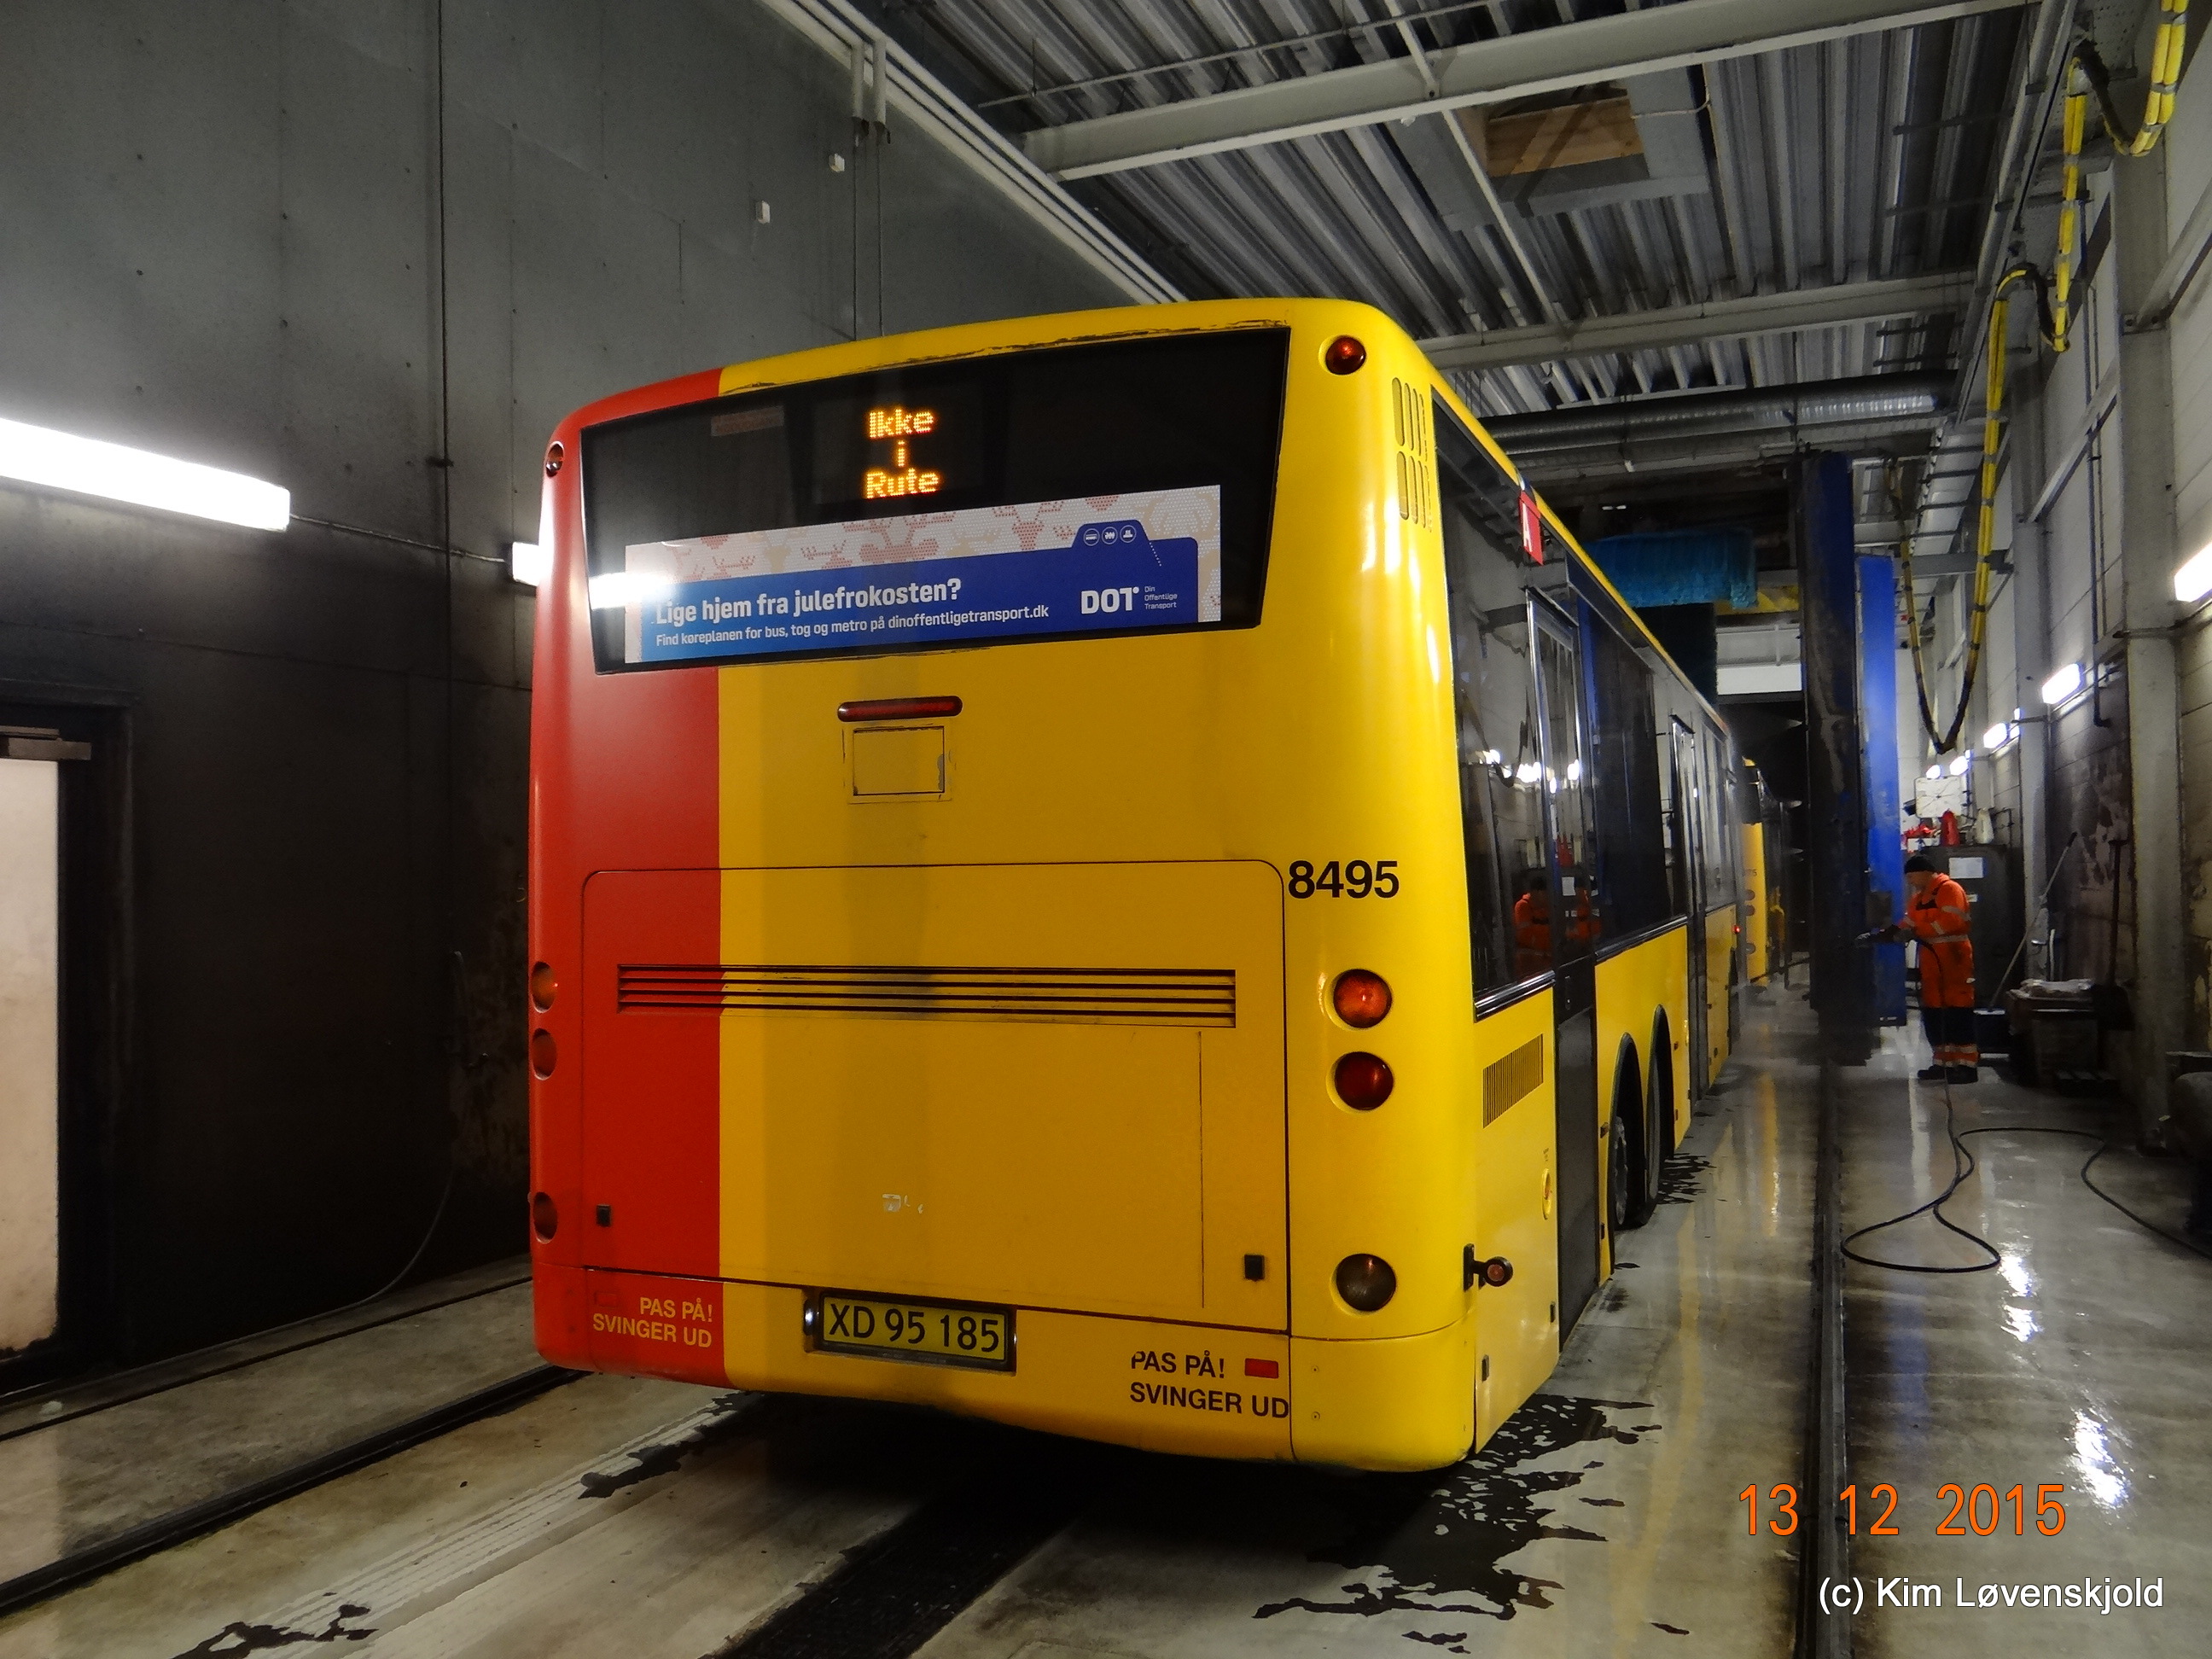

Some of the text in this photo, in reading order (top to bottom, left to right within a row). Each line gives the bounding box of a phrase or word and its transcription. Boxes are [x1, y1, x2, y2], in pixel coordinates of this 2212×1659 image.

[869, 409, 934, 438] Ikke
[898, 440, 905, 467] i
[866, 468, 940, 499] Rute
[656, 577, 962, 626] Lige hjem fra julefrokosten?
[1081, 586, 1139, 614] DOT
[656, 604, 1049, 646] Find køreplanen for bus, tog og metro på dinoffentligetransport.dk
[1288, 859, 1400, 899] 8495
[640, 1297, 713, 1323] PAS PÅ!
[592, 1313, 712, 1348] SVINGER UD
[829, 1303, 999, 1353] XD 95 185
[1131, 1350, 1225, 1378] PAS PÅ!
[1130, 1382, 1289, 1418] SVINGER UD
